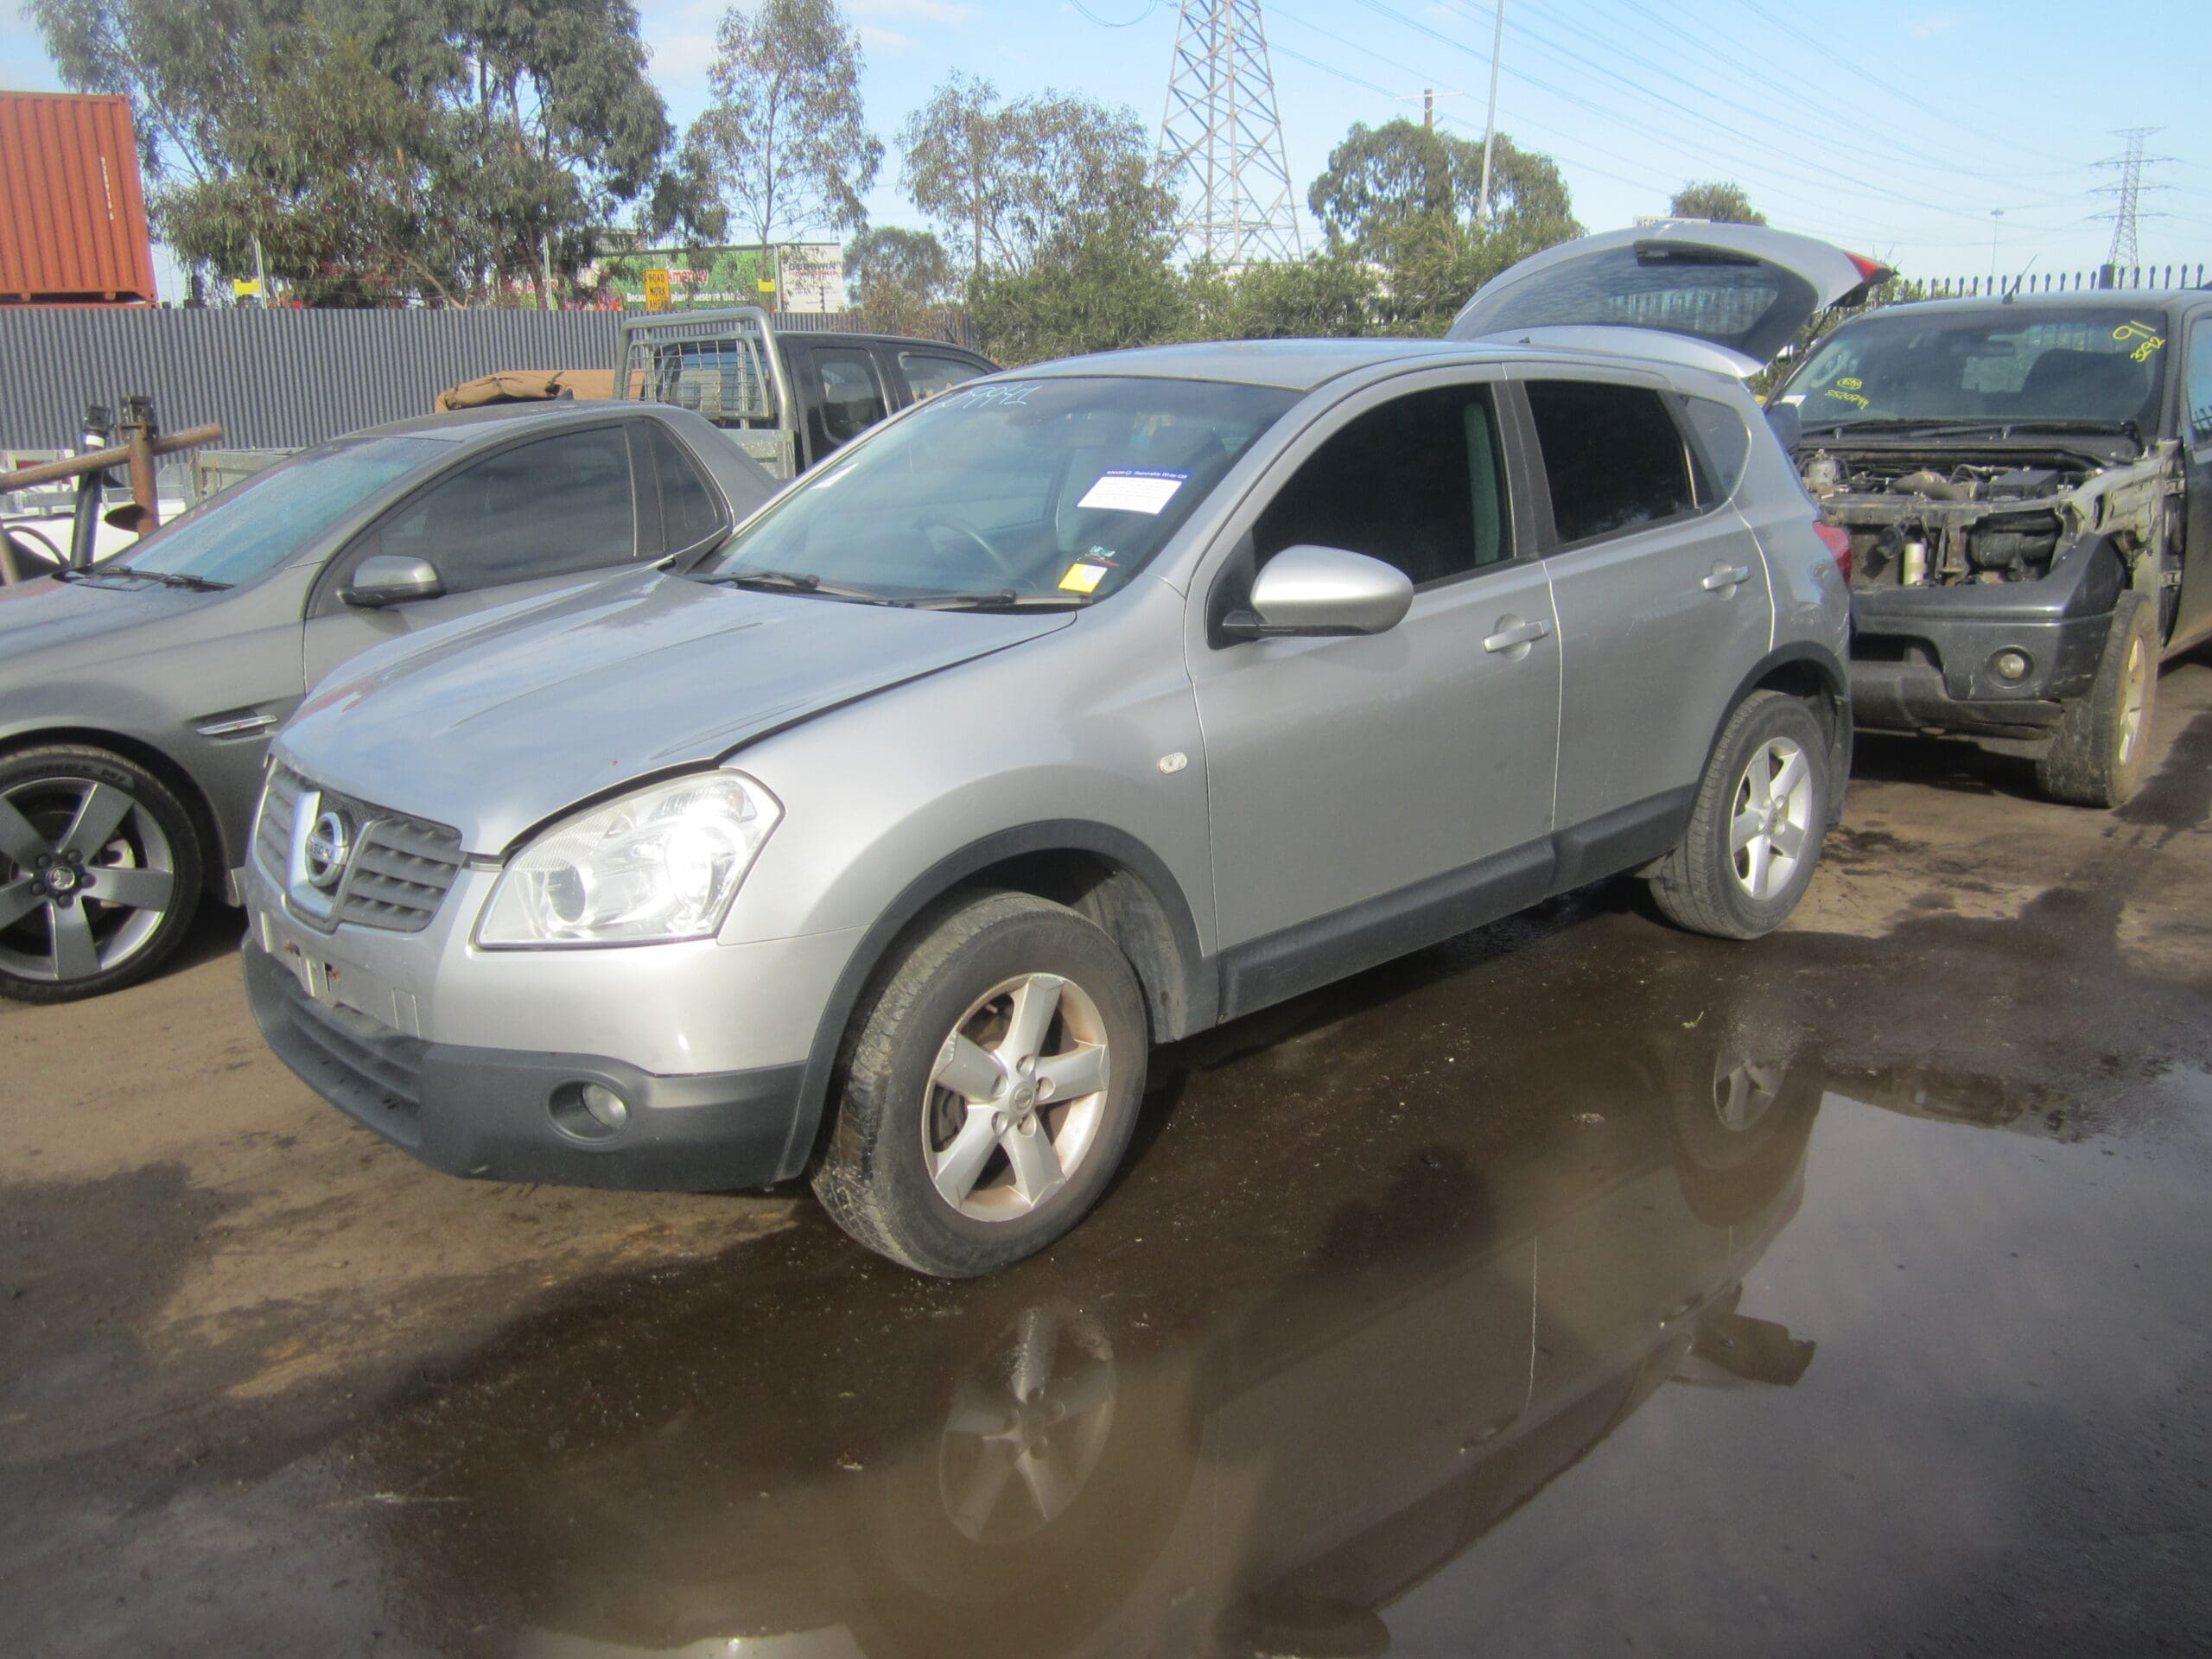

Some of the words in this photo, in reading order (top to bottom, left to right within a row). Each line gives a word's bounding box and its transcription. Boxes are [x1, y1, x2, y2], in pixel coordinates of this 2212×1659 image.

[648, 274, 665, 283] ROAD
[650, 287, 666, 296] WORK
[722, 291, 735, 302] the
